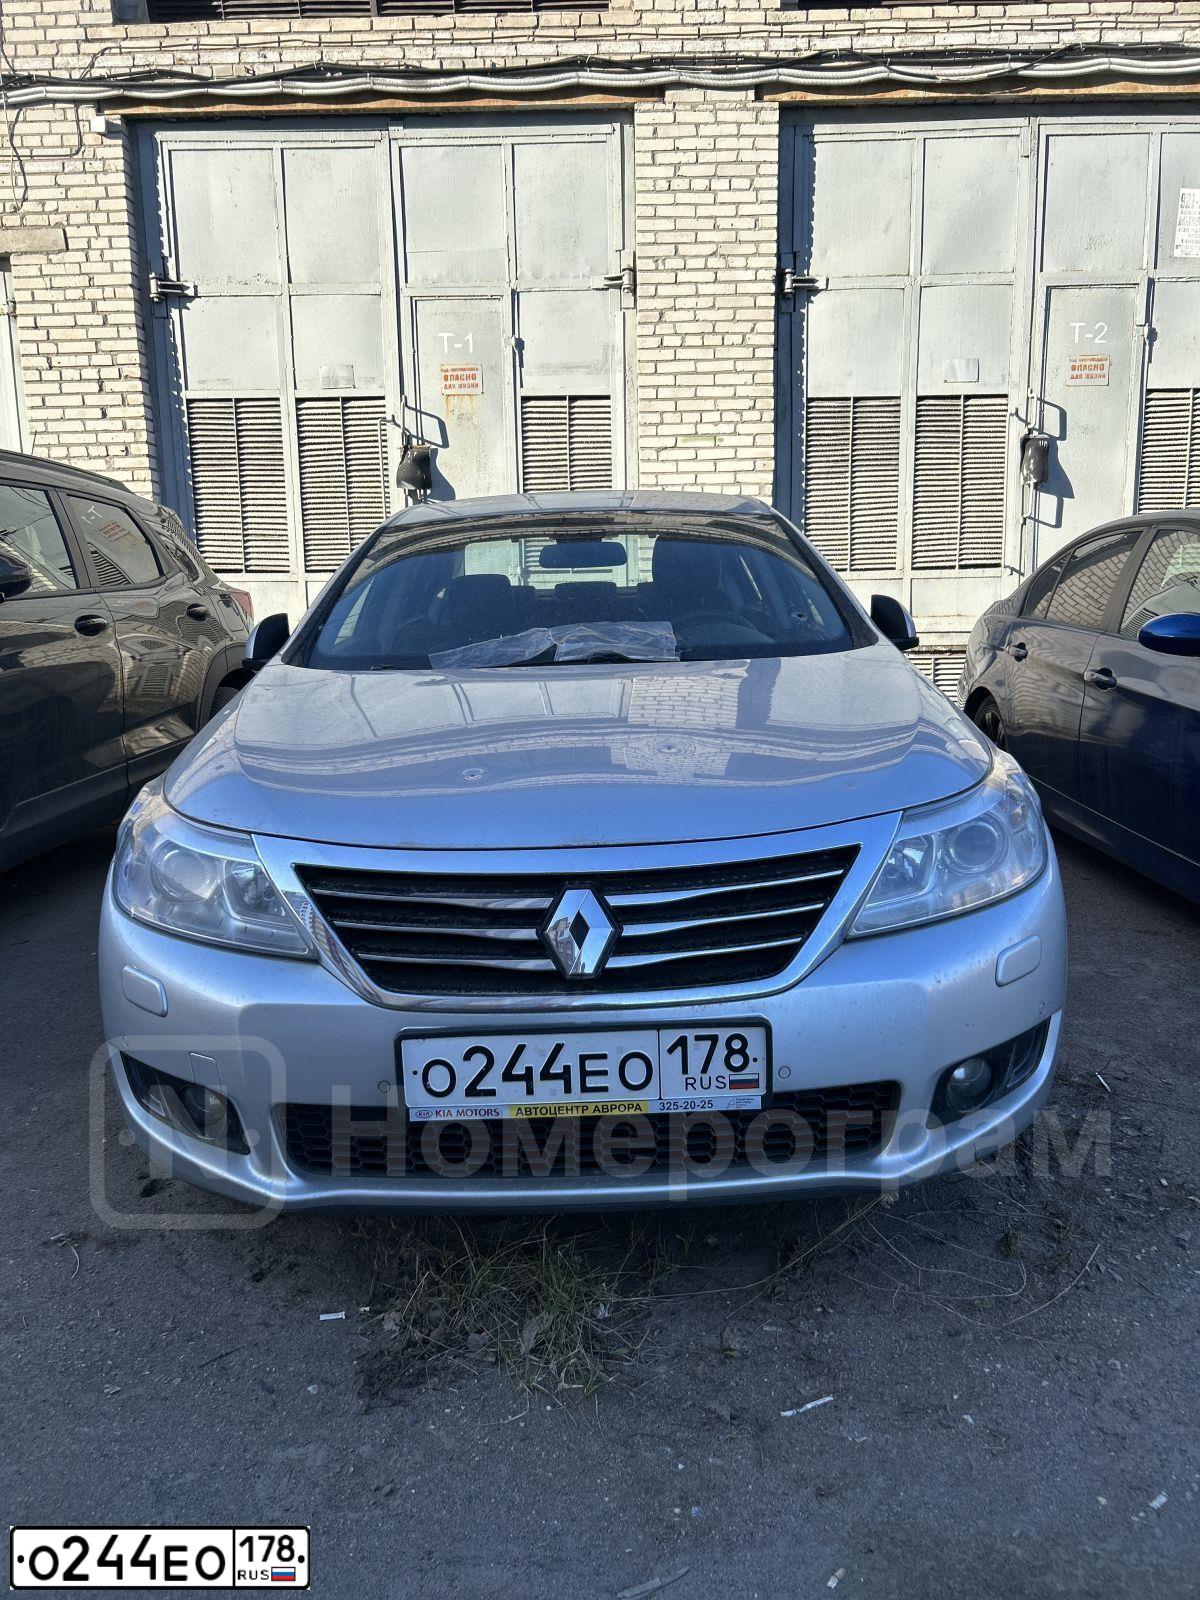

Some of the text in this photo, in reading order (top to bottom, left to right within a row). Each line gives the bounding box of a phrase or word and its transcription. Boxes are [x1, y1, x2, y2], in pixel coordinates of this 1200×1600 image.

[1070, 322, 1107, 343] Т-2
[438, 333, 473, 353] Т-1
[421, 1033, 750, 1098] О244ЕО 178
[685, 1075, 727, 1091] RUS
[435, 1110, 453, 1118] KIA
[456, 1108, 500, 1117] MOTORS
[515, 1103, 643, 1117] АВТОЦЕНТР АВРОРА
[659, 1101, 714, 1111] 325-20-25
